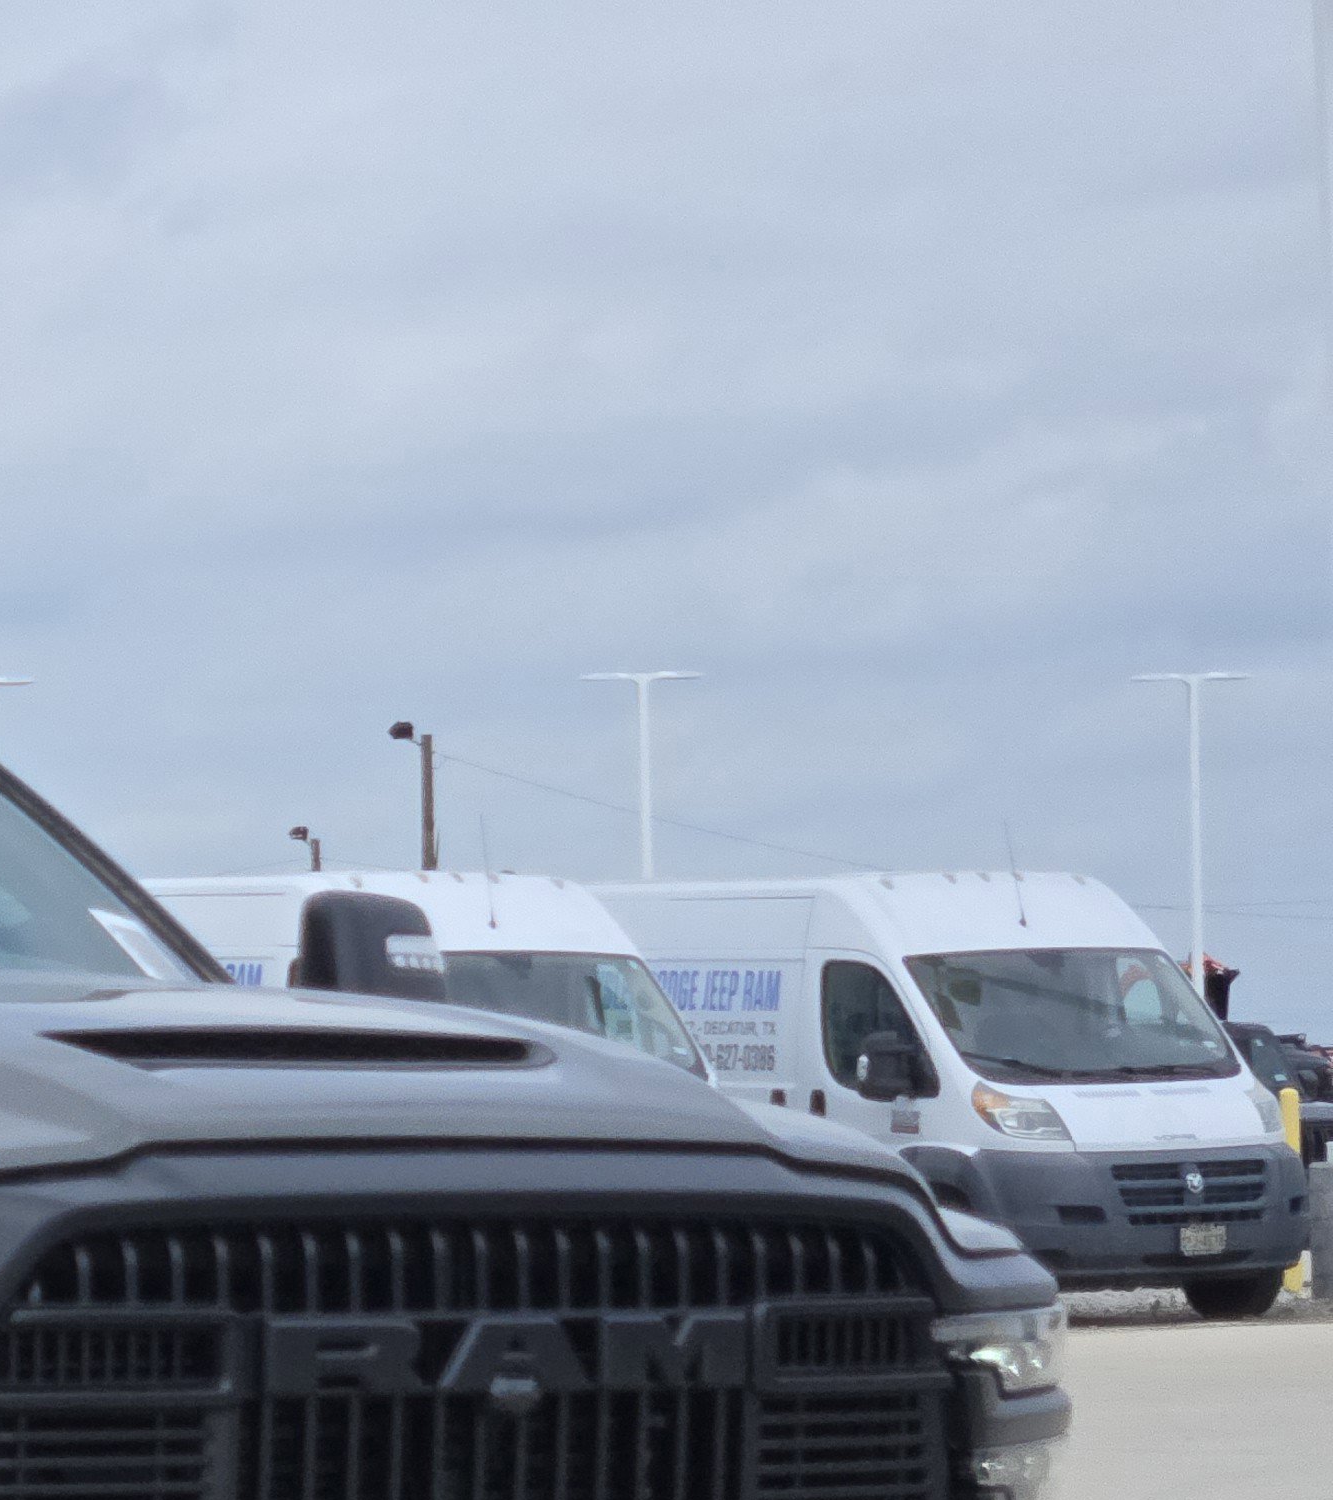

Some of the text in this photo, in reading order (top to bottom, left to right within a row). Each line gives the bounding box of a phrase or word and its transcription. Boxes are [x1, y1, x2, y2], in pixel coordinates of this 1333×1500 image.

[702, 969, 740, 1011] JEEP
[742, 969, 782, 1011] RAM
[264, 1312, 749, 1394] RAM
